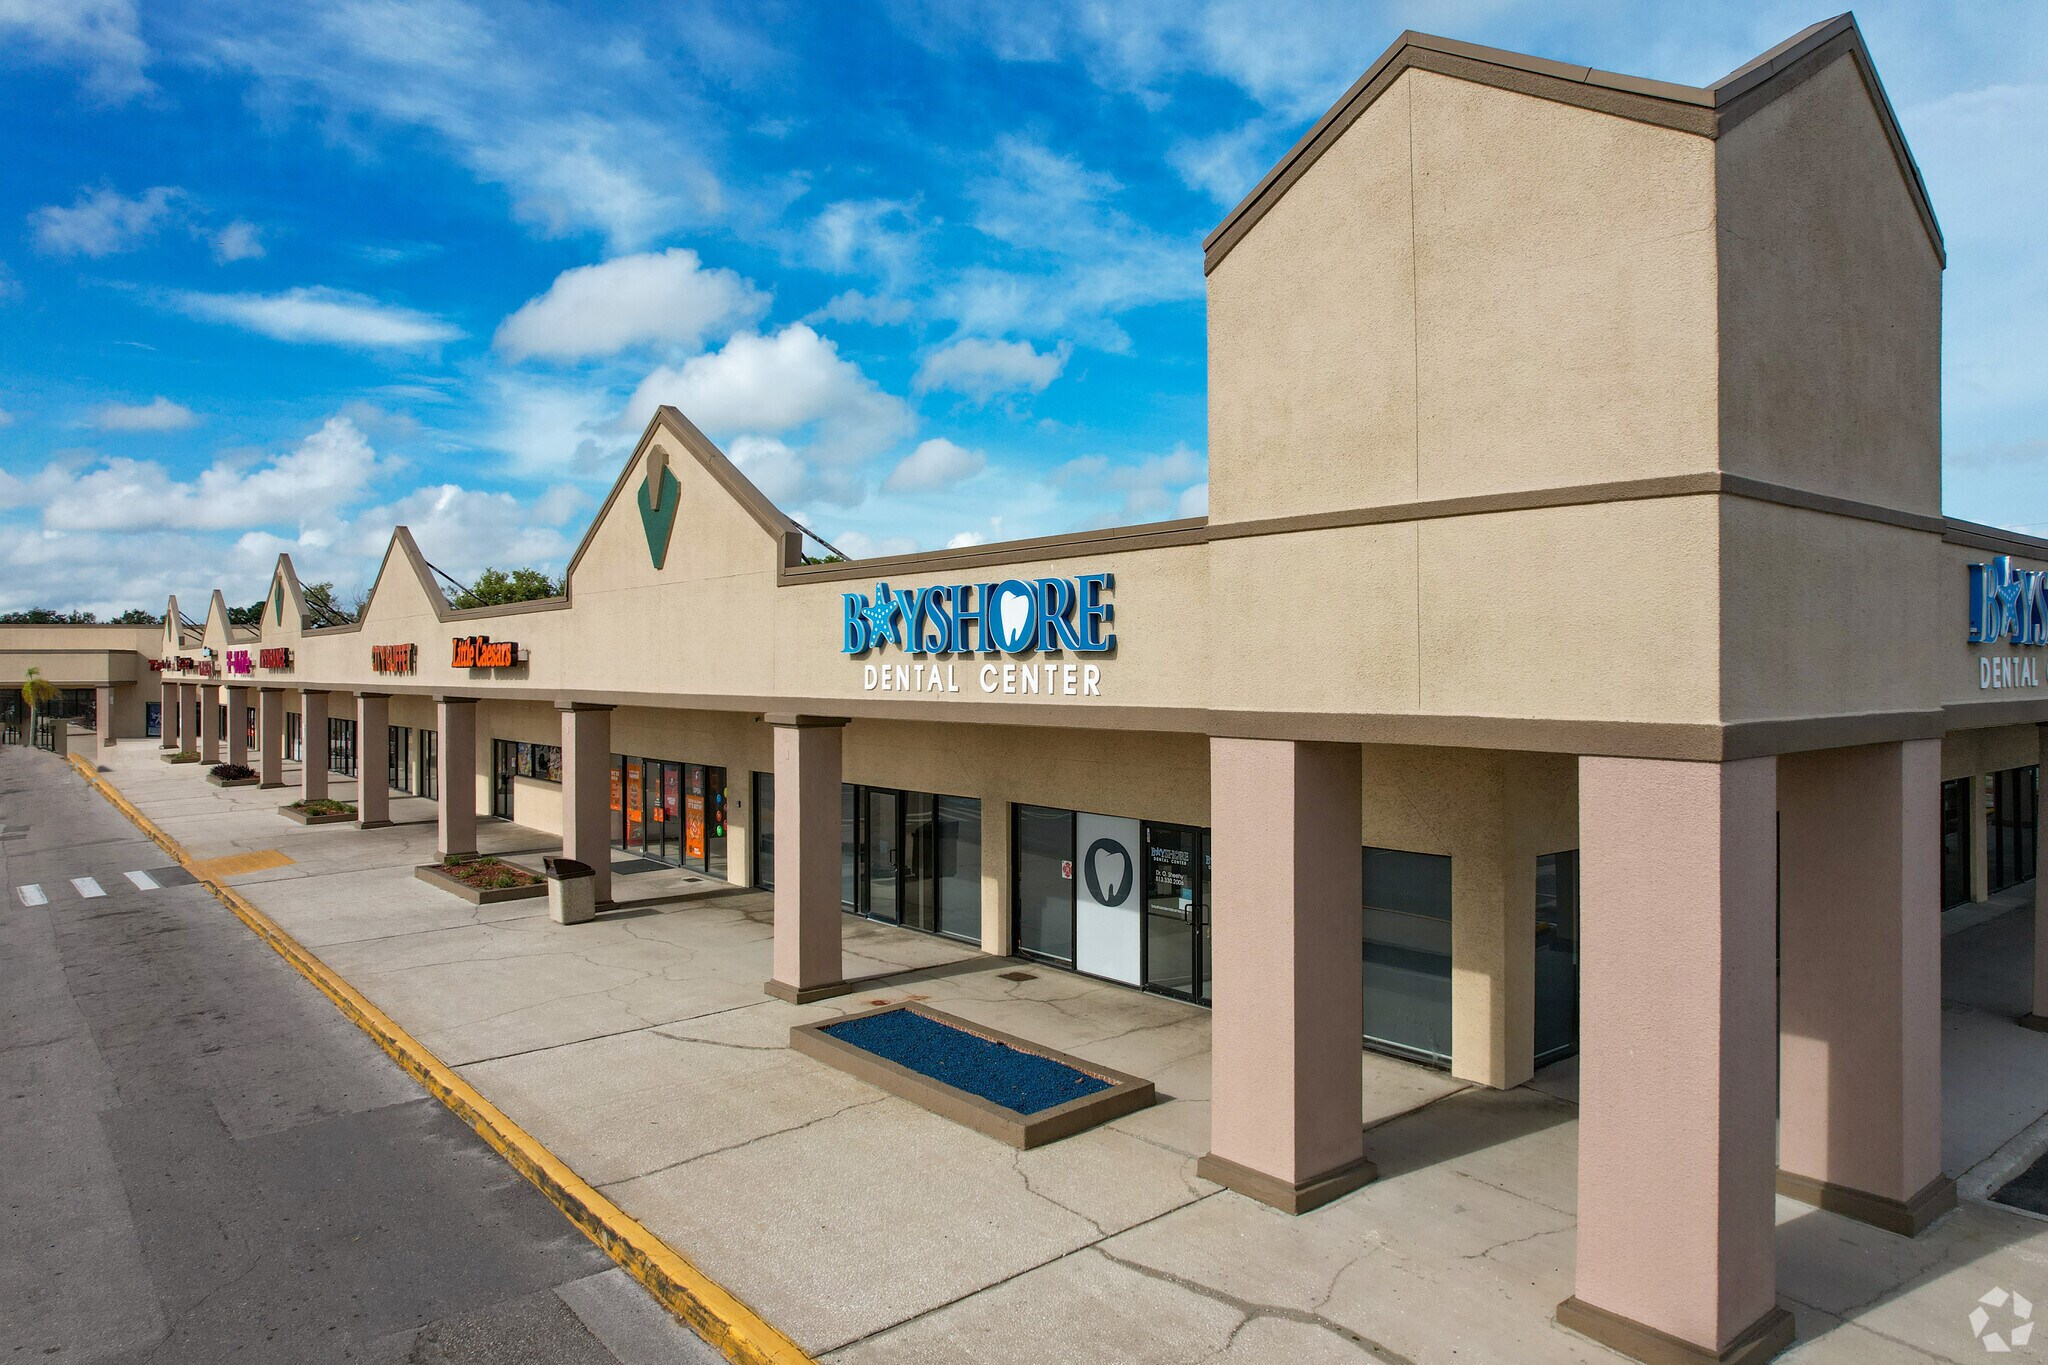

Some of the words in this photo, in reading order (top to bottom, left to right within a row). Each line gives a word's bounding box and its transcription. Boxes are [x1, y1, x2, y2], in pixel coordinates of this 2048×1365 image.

[840, 573, 1116, 655] BAYSHORE
[452, 636, 475, 667] Little
[475, 635, 515, 667] Caesars
[864, 664, 959, 692] DENTAL
[979, 663, 1101, 696] CENTER
[1980, 657, 2038, 689] DENTAL
